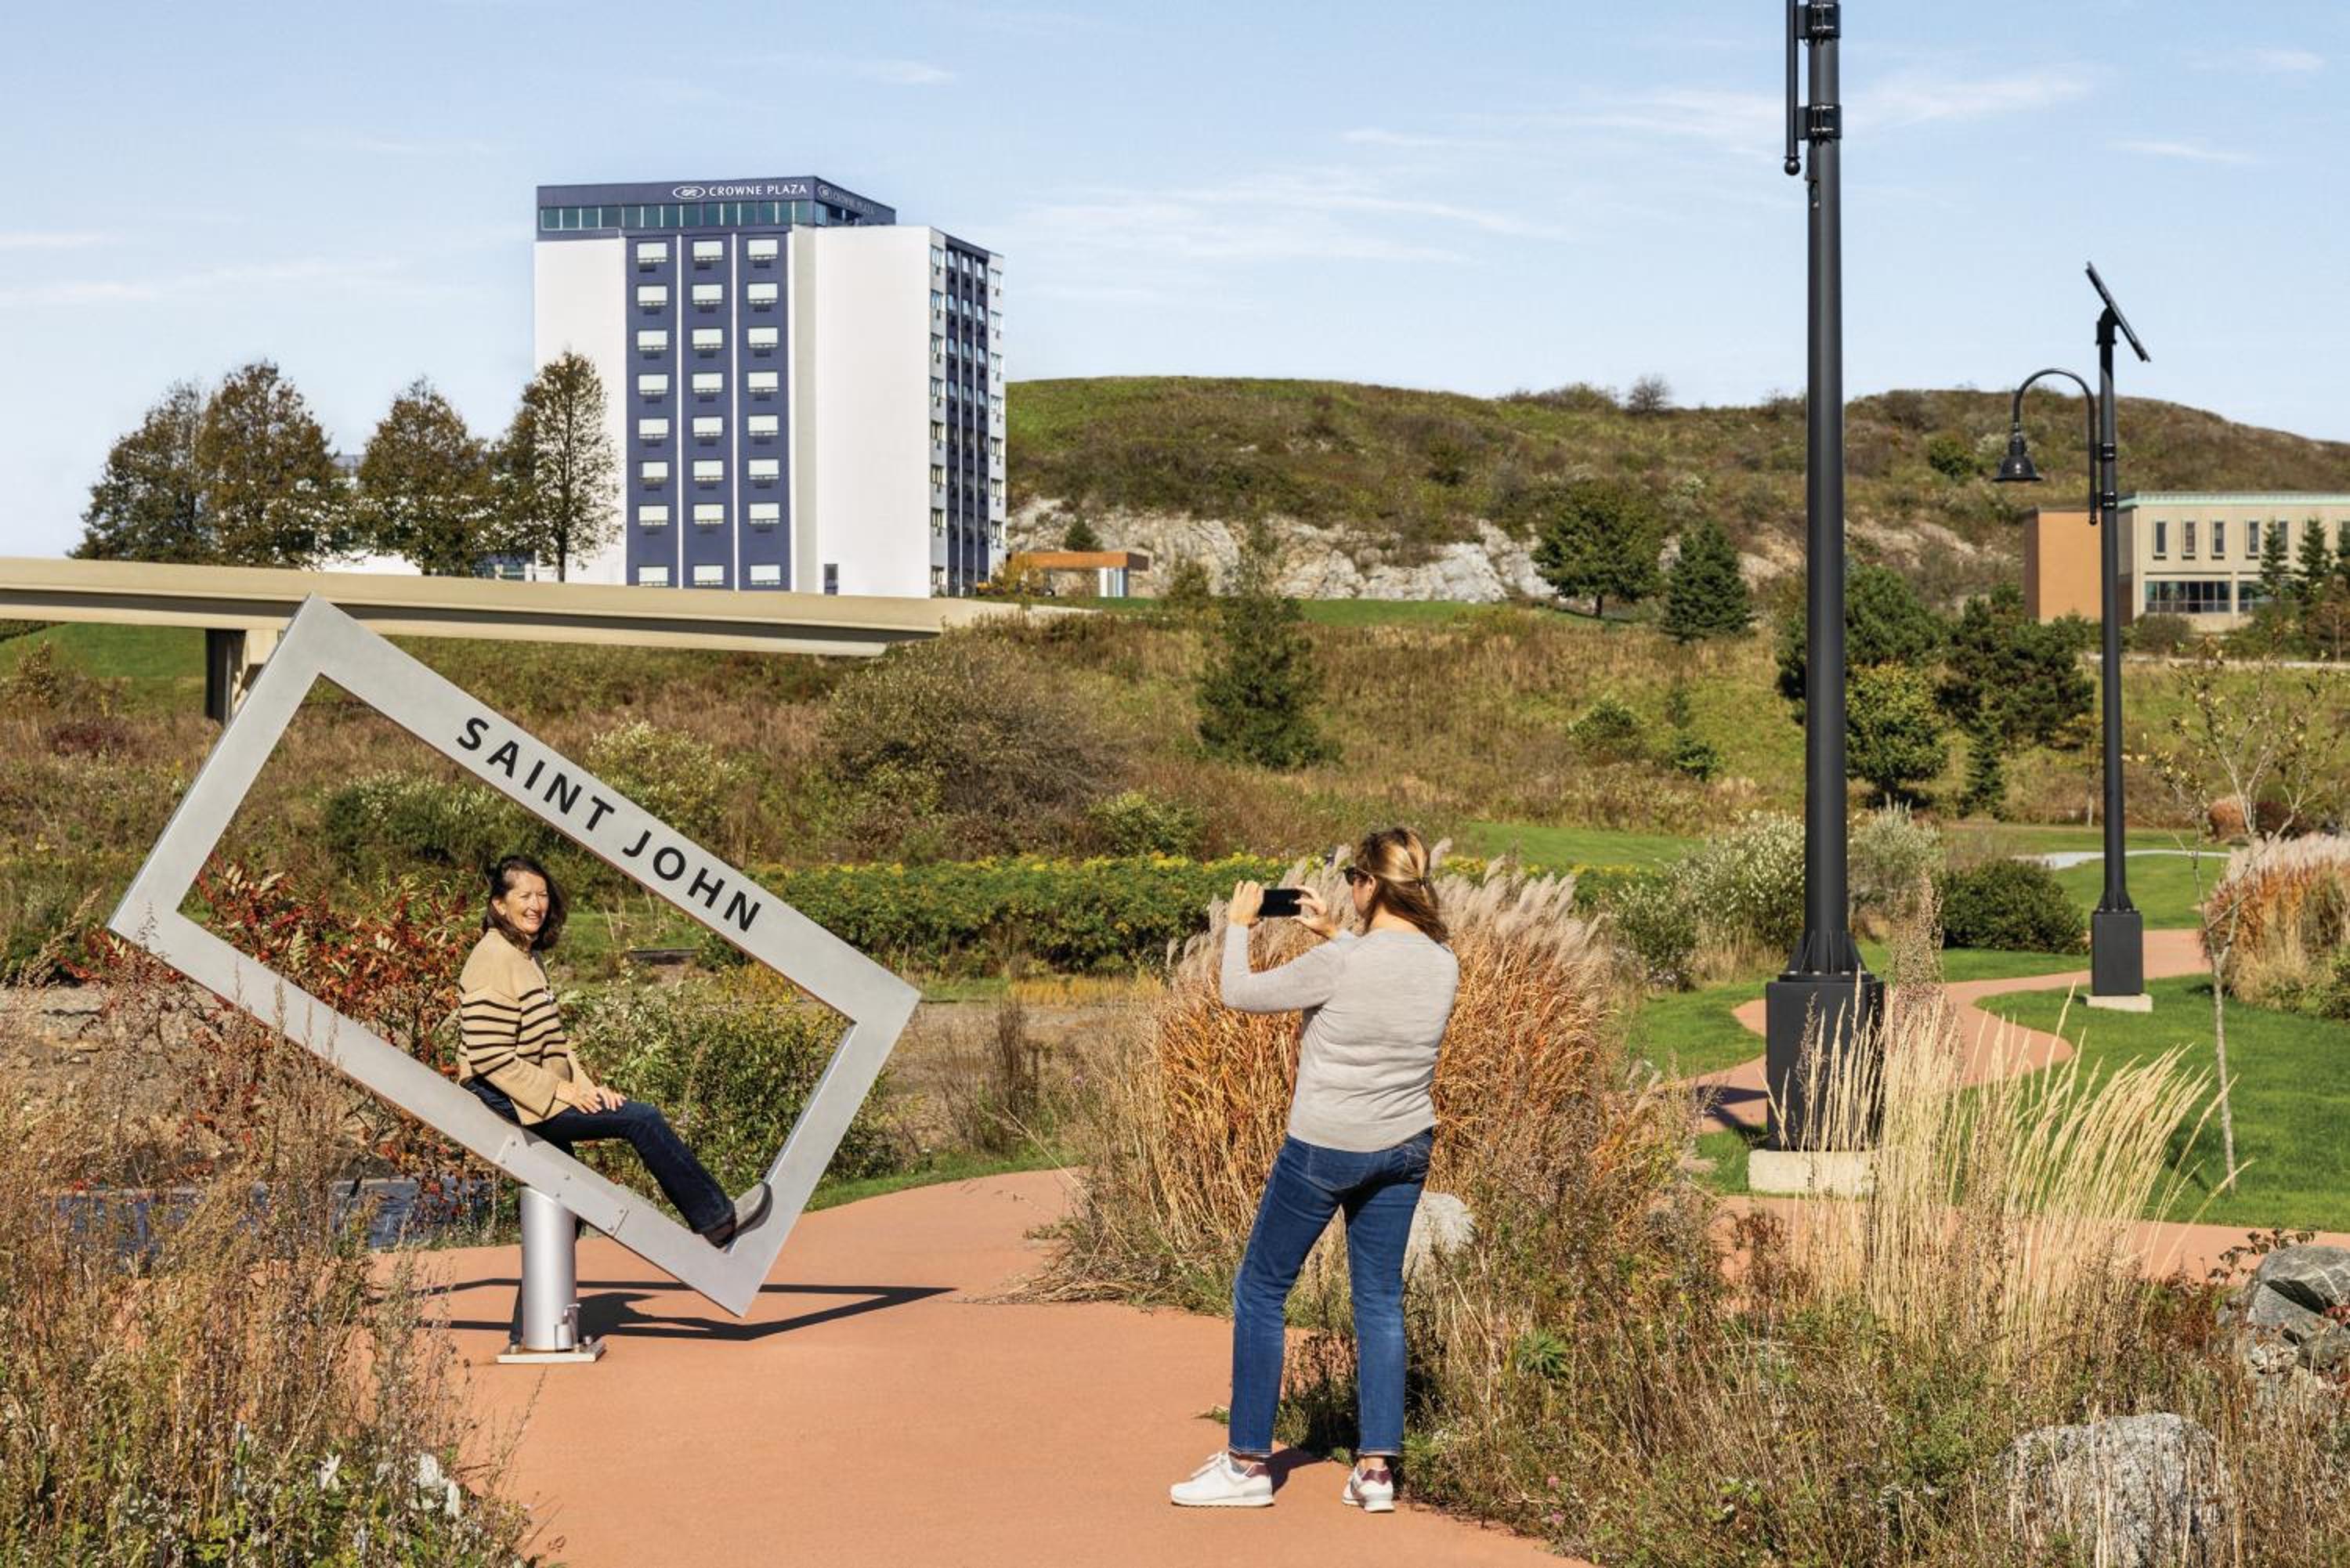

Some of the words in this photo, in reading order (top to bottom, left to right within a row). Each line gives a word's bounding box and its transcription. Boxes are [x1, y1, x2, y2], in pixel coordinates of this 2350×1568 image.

[709, 185, 763, 197] CROWNE
[767, 184, 807, 195] PLAZA
[456, 717, 615, 832] SAINT
[622, 829, 761, 932] JOHN
